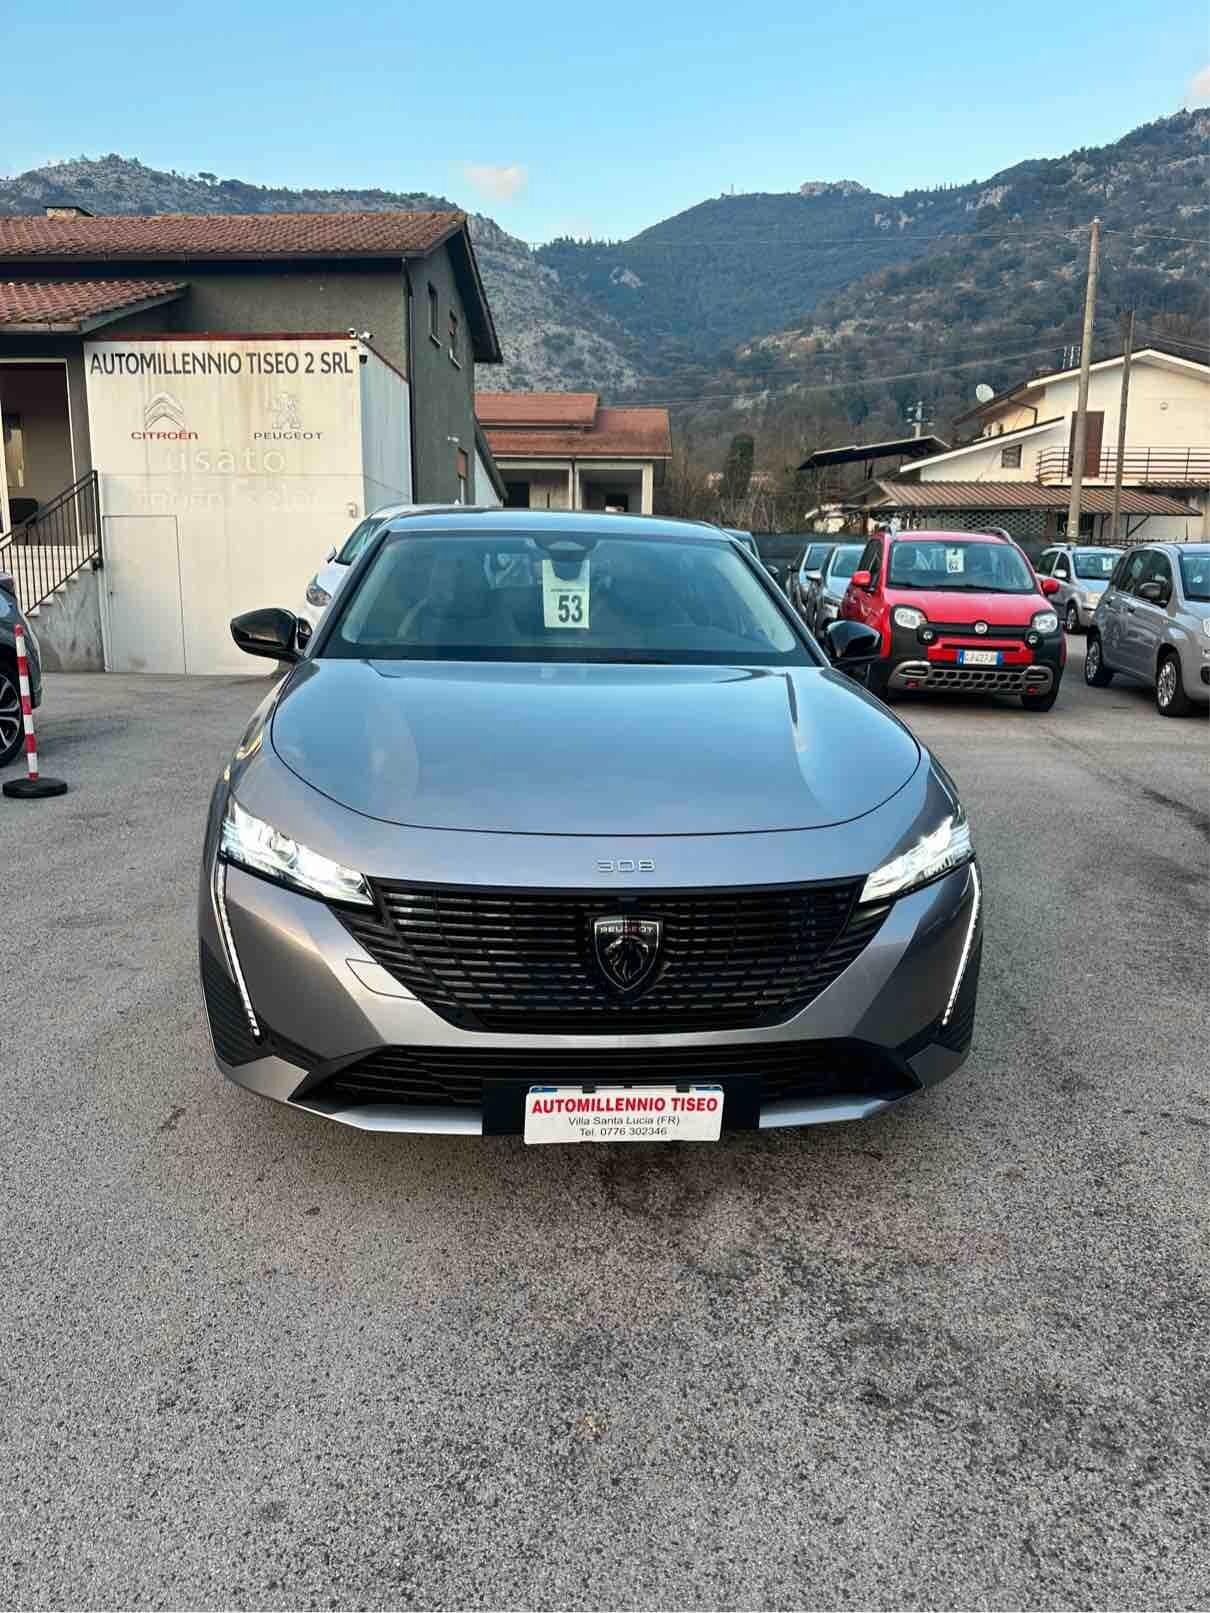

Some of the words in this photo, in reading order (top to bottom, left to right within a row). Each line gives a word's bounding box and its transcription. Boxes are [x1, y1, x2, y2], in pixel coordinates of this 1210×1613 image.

[90, 352, 242, 375] AUTOMILLENNIO
[246, 352, 299, 374] TISEO
[304, 352, 314, 374] 2
[321, 352, 353, 374] SRL
[253, 431, 323, 440] PEUGEOT
[558, 595, 583, 623] 53
[597, 859, 656, 873] 308
[531, 1098, 666, 1114] AUTOMILLENNIO
[671, 1097, 718, 1112] TISEO
[568, 1117, 590, 1127] Villa
[593, 1116, 623, 1126] Santa
[626, 1115, 653, 1126] Lucia
[656, 1115, 680, 1126] (FR)
[579, 1127, 596, 1137] Tel.
[600, 1126, 626, 1137] 0776
[629, 1126, 667, 1136] 302346
